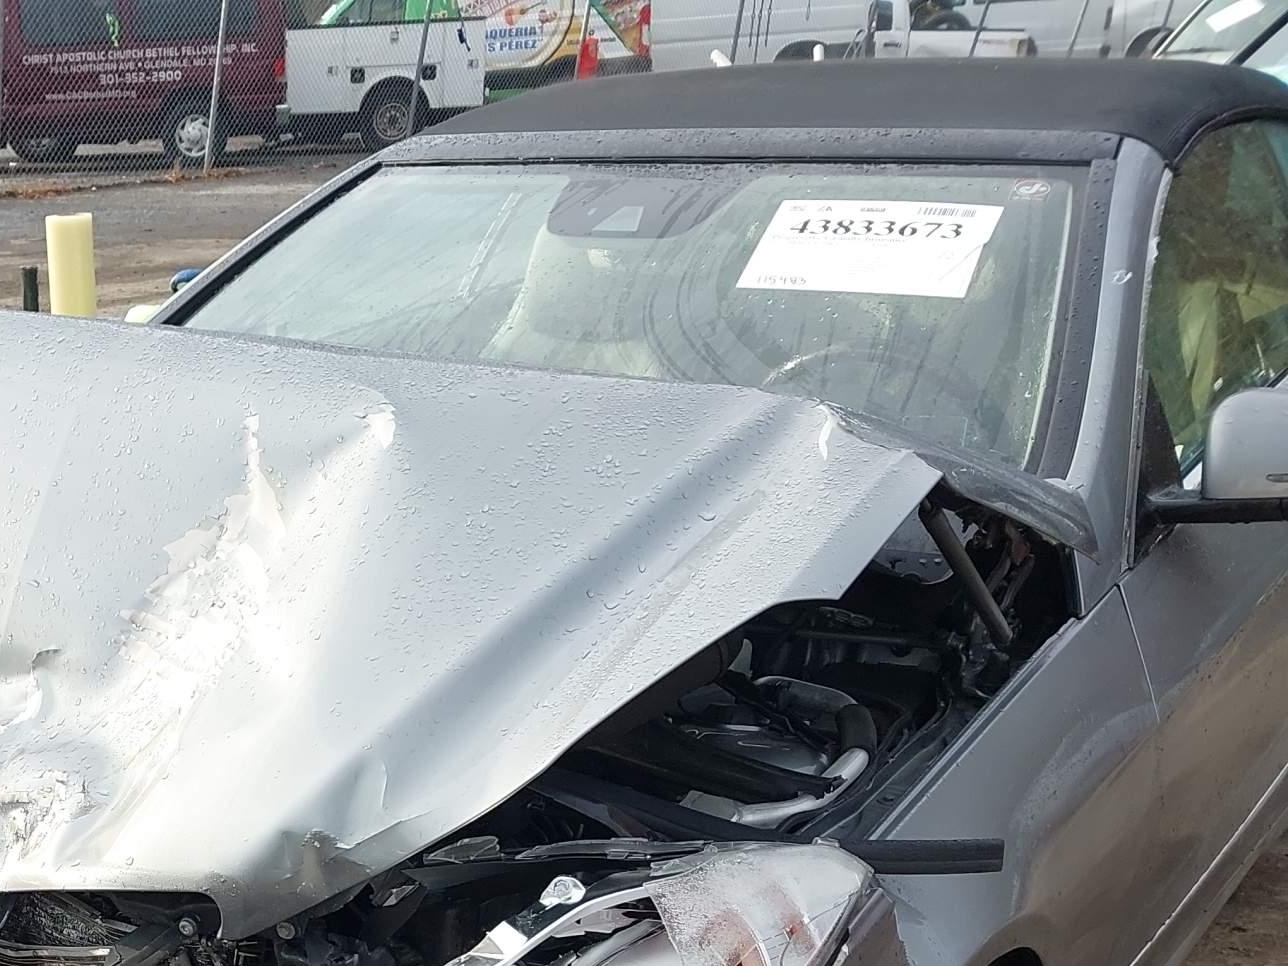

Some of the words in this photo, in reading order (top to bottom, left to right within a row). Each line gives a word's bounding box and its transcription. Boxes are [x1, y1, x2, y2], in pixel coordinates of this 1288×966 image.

[22, 54, 53, 65] CHRIST
[56, 51, 106, 63] APOSTOLIC
[108, 49, 143, 59] CHURCH
[145, 47, 180, 58] BETHEL
[70, 62, 117, 73] NORTHERN
[100, 70, 182, 84] 301-352-2900
[790, 218, 963, 239] 43833673
